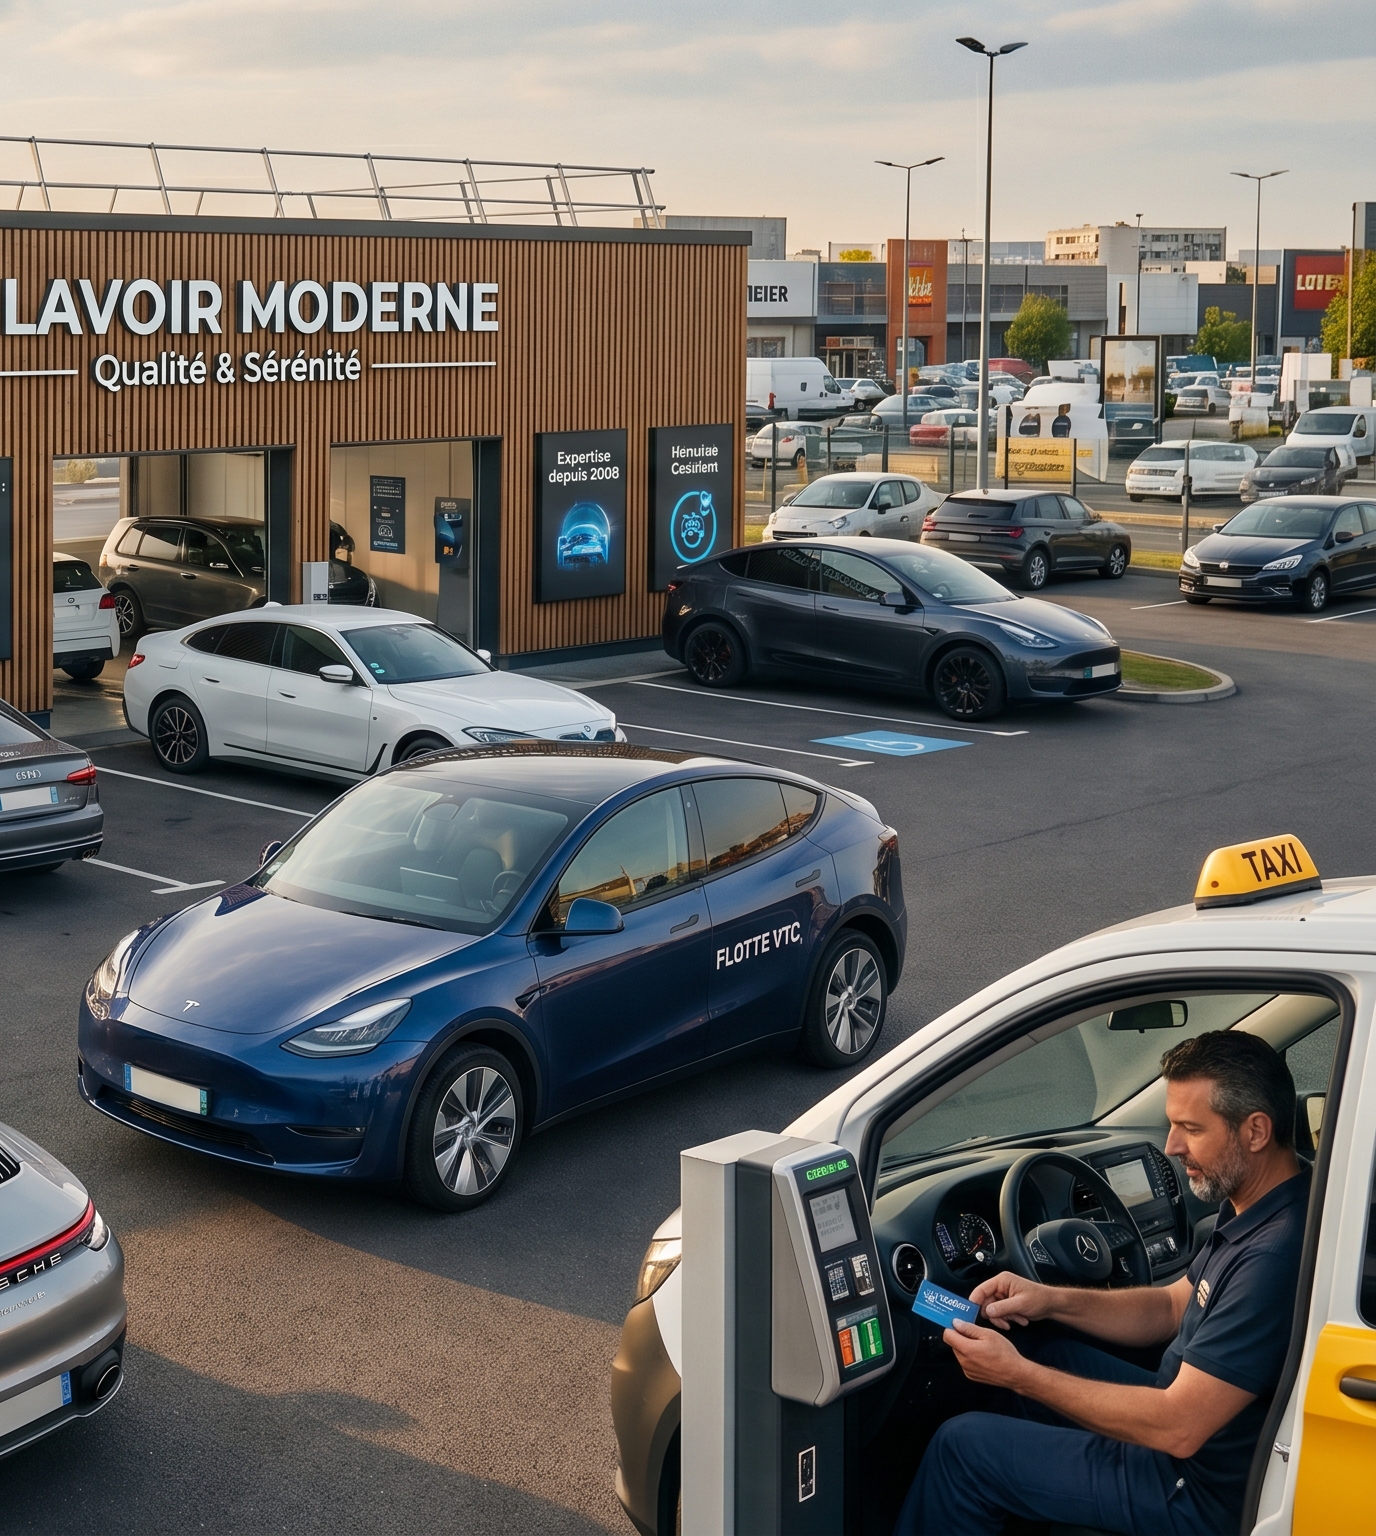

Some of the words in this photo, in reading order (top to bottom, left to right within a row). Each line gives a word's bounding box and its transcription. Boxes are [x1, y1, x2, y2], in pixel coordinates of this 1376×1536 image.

[4, 278, 222, 336] LAVOIR
[240, 280, 499, 334] MODERNE
[94, 350, 207, 392] Qualité
[215, 354, 236, 384] &
[243, 348, 362, 383] Sérénité
[548, 467, 588, 486] depuis
[590, 466, 620, 481] 2008
[557, 449, 611, 467] Expertise
[1241, 842, 1303, 882] TAXI
[716, 931, 770, 970] FLOTTE
